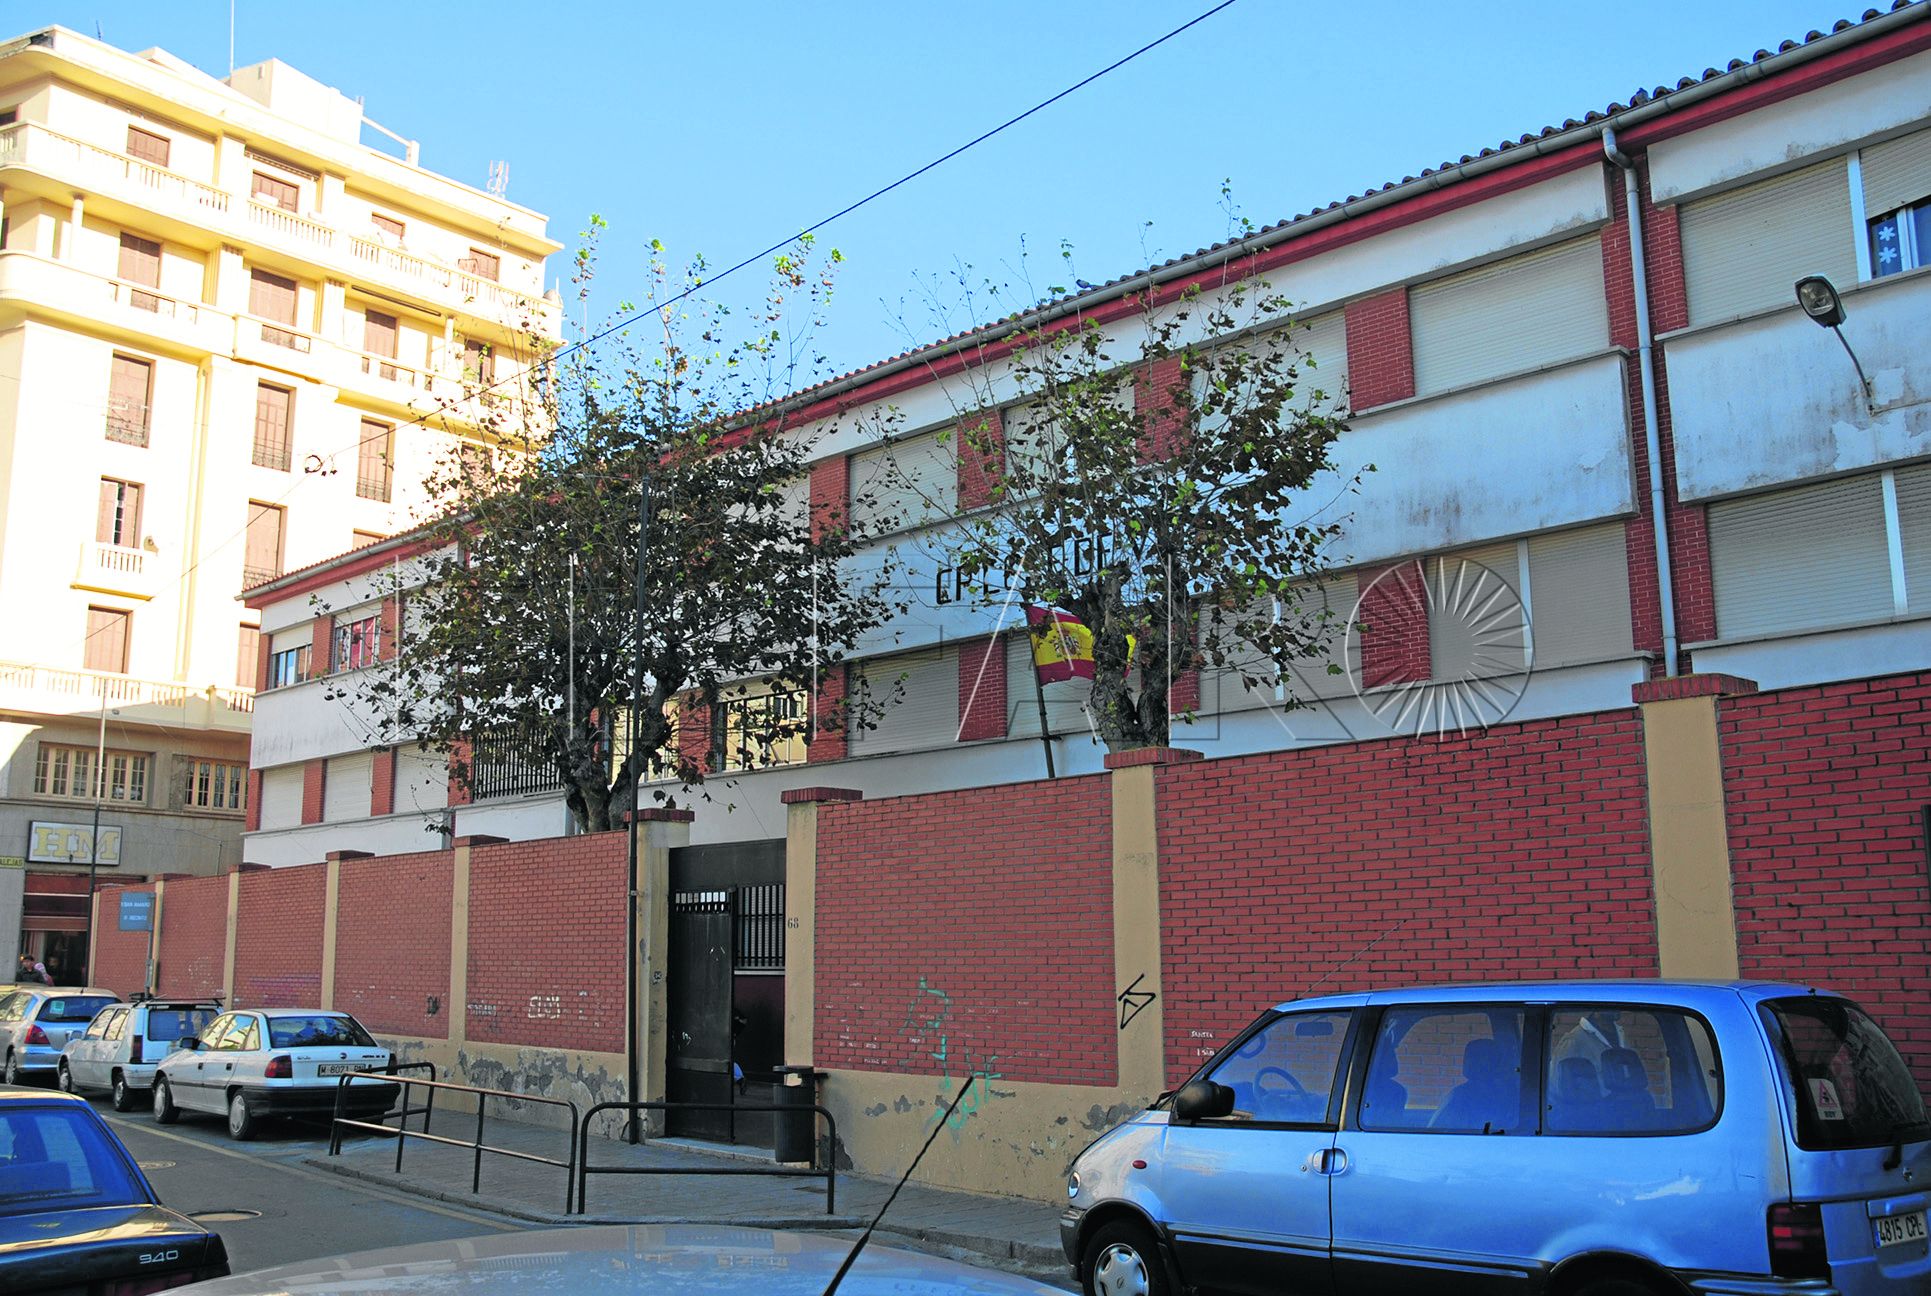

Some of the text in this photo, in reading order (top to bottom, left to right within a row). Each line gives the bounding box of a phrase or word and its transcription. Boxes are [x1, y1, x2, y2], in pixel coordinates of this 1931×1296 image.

[32, 826, 120, 860] HM
[787, 917, 799, 929] 68
[330, 1066, 349, 1074] 8071
[1879, 1217, 1903, 1242] 4815
[139, 1250, 179, 1264] 940
